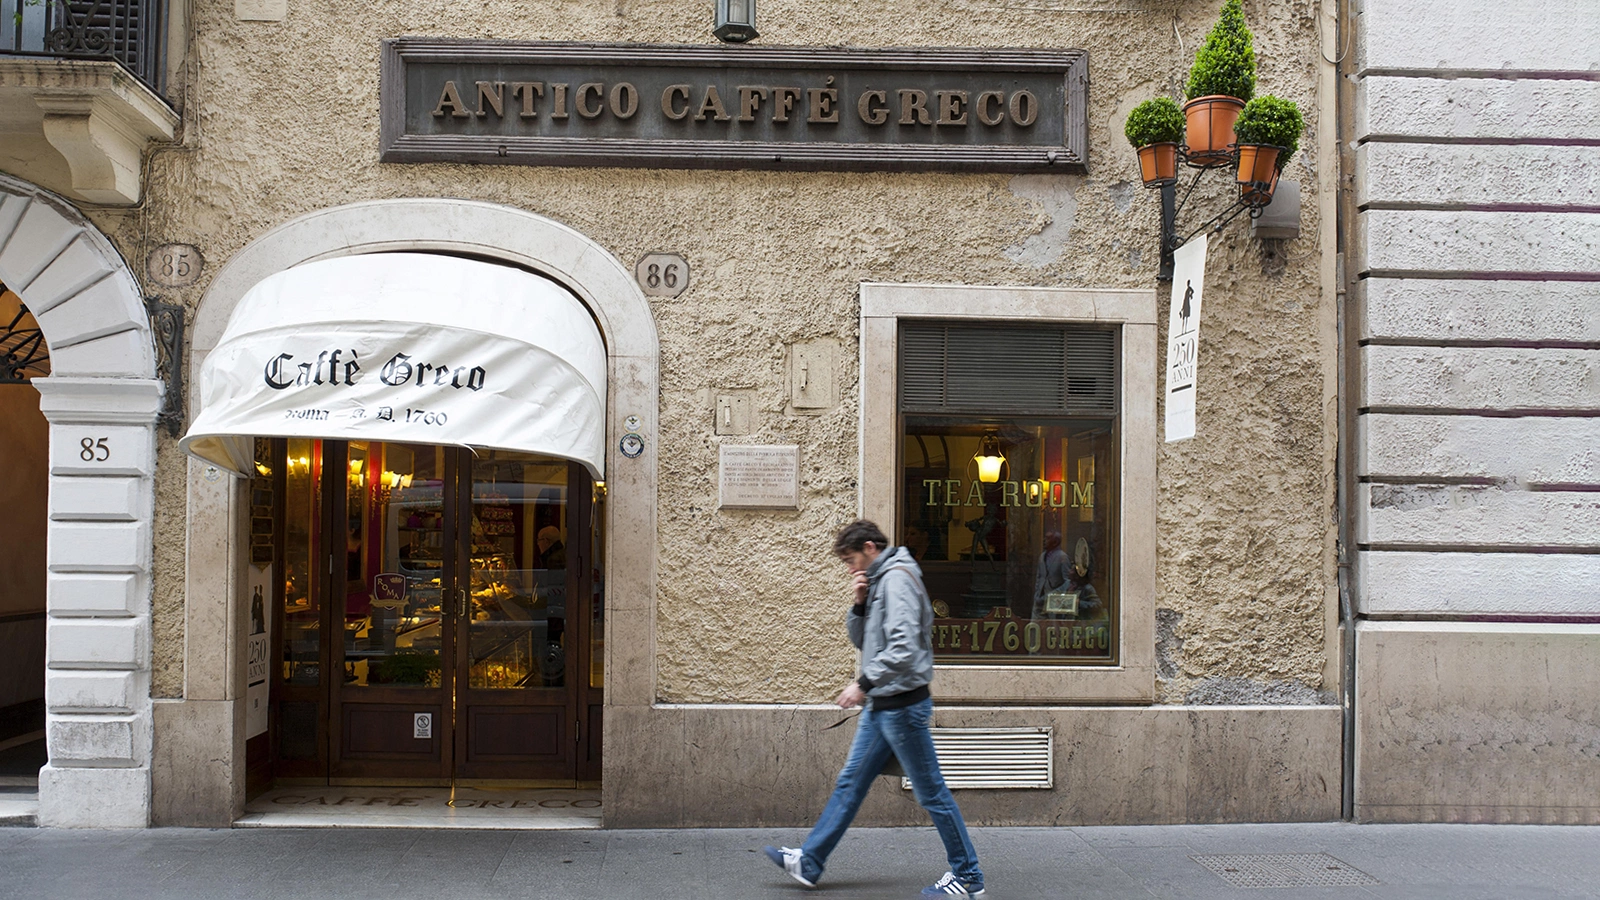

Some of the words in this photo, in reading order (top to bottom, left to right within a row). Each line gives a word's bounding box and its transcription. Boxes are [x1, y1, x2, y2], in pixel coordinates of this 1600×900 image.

[432, 81, 639, 121] ANTICO
[660, 75, 839, 124] CAFFÉ
[857, 90, 1038, 127] GRECO
[162, 254, 190, 277] 85
[647, 263, 678, 289] 86
[1173, 338, 1195, 368] 250
[264, 349, 360, 390] Caffè
[379, 352, 486, 392] Greco
[1171, 366, 1193, 383] ANNI
[376, 406, 396, 422] D.
[405, 408, 448, 426] 1760
[80, 436, 110, 462] 85
[923, 480, 987, 507] TEA
[1000, 481, 1094, 508] ROOM
[377, 578, 400, 600] ROMA
[969, 621, 1042, 653] 1760
[248, 639, 267, 664] 250
[248, 663, 266, 679] ANNI
[445, 799, 602, 808] GRECO
